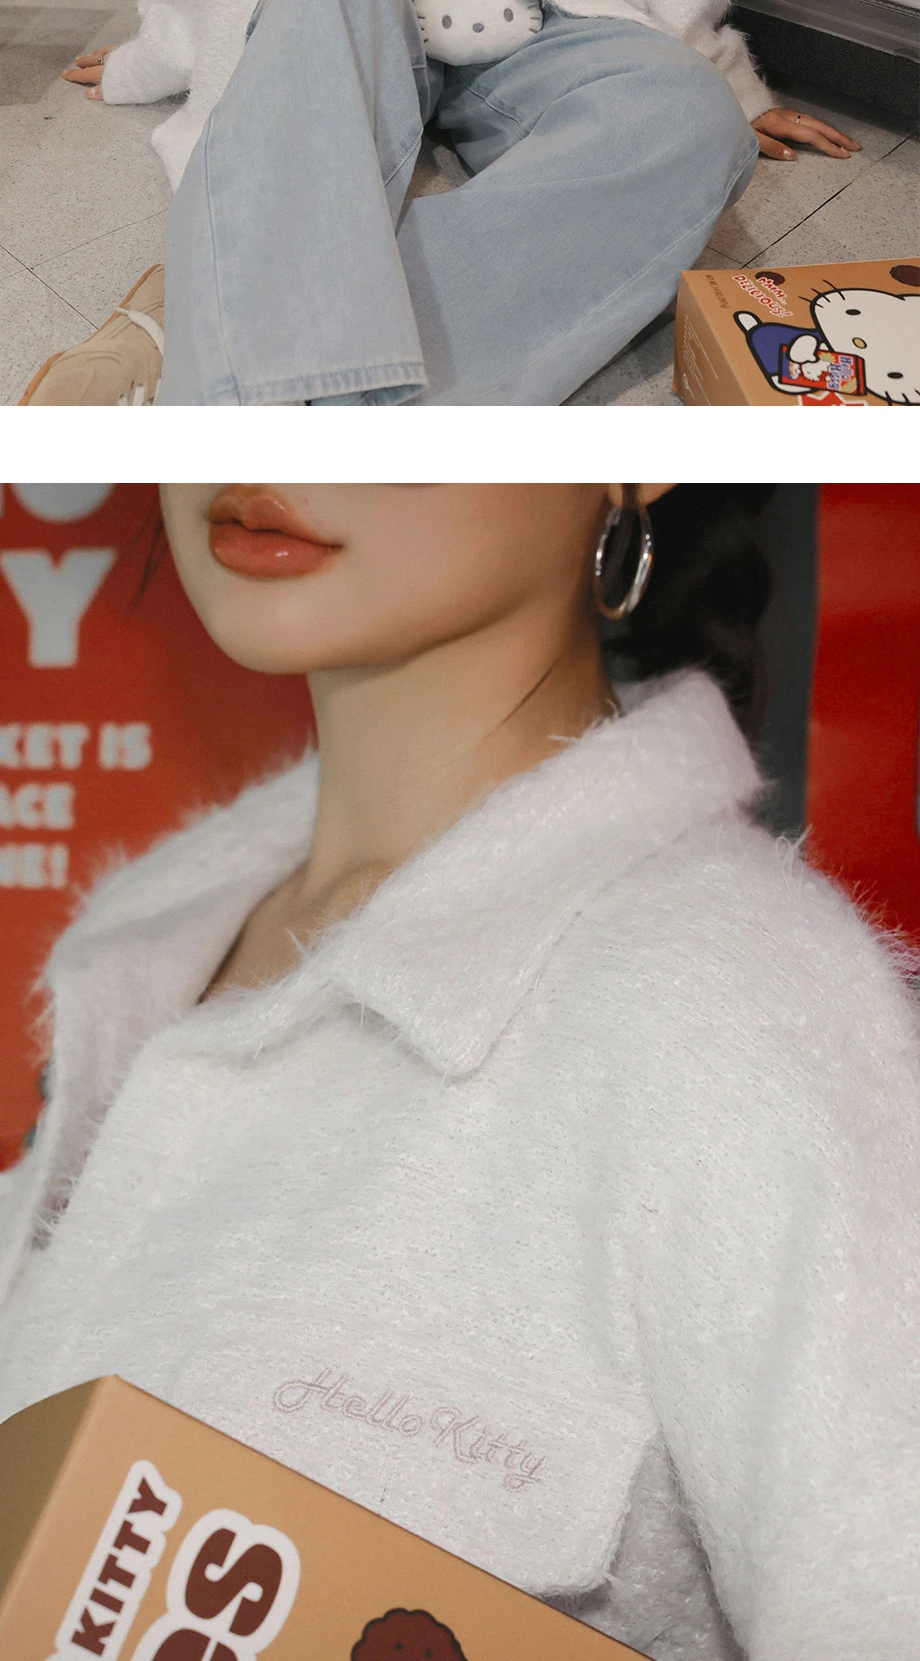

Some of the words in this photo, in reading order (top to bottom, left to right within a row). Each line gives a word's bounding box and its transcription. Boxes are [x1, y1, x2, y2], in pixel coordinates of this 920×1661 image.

[733, 274, 794, 318] DELICIOUS!
[99, 722, 153, 771] IS
[273, 1366, 425, 1438] Hello
[430, 1405, 549, 1493] Kitty
[70, 1476, 168, 1657] KITTY
